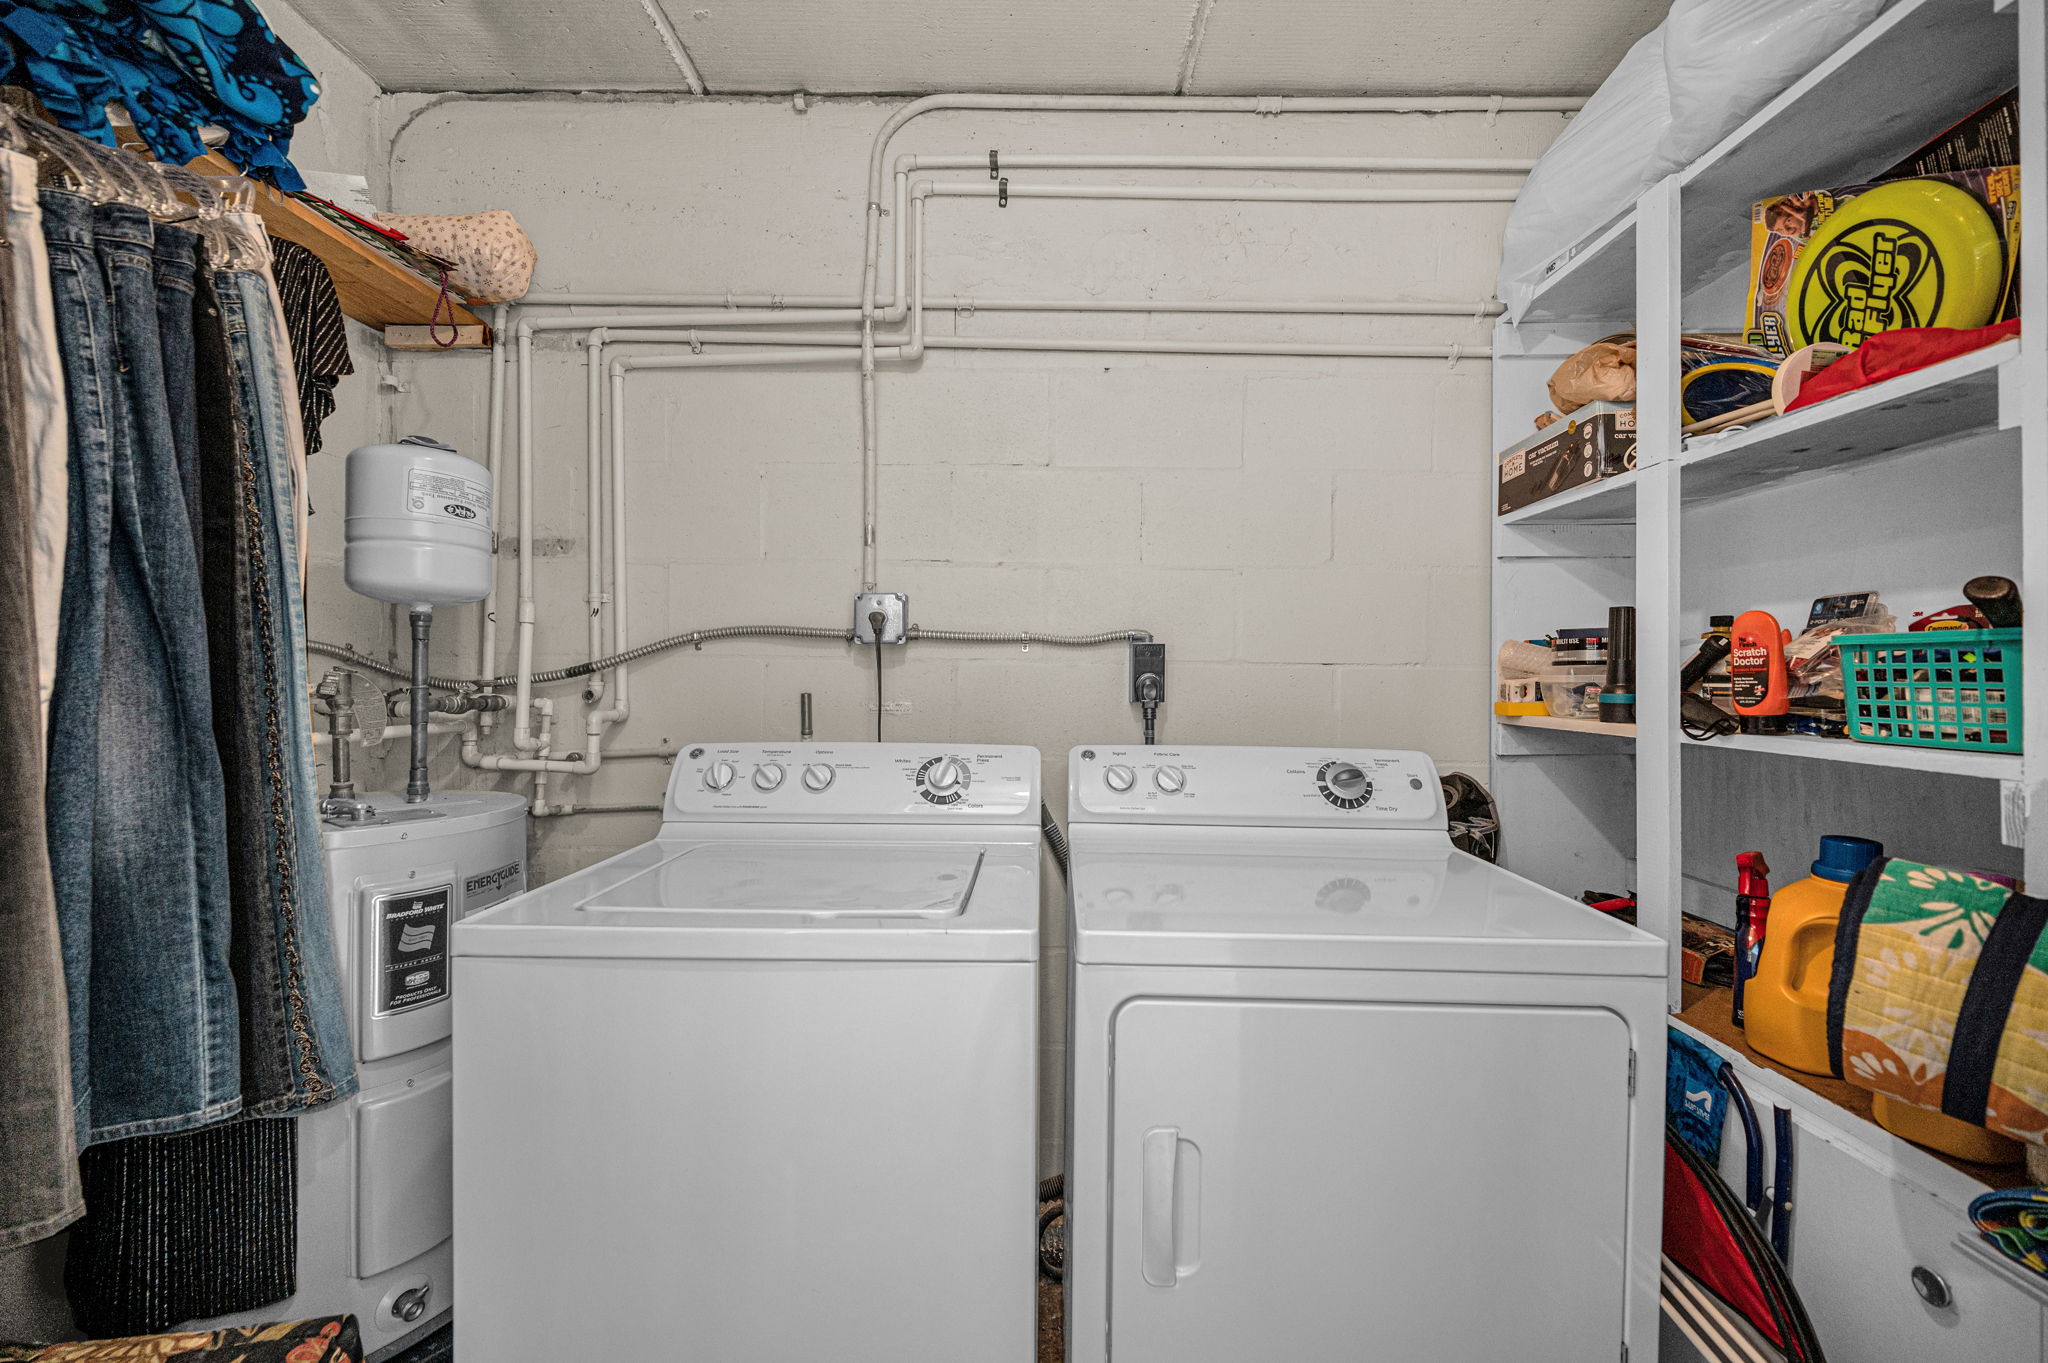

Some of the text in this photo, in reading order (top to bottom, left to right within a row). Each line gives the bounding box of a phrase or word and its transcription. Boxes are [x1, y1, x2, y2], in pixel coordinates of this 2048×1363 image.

[1866, 234, 1894, 334] Flyer
[1841, 287, 1866, 349] Rad
[1763, 317, 1785, 358] LYER
[1504, 462, 1523, 477] HOME
[1733, 647, 1767, 657] Scratch
[1733, 657, 1763, 666] Doctor
[466, 863, 520, 892] ENERGYGUIDE
[386, 903, 445, 920] BRADFORD WHITE
[389, 988, 442, 1007] FOR PROFESSIONALS
[396, 985, 437, 1000] PRODUCTS ONLY
